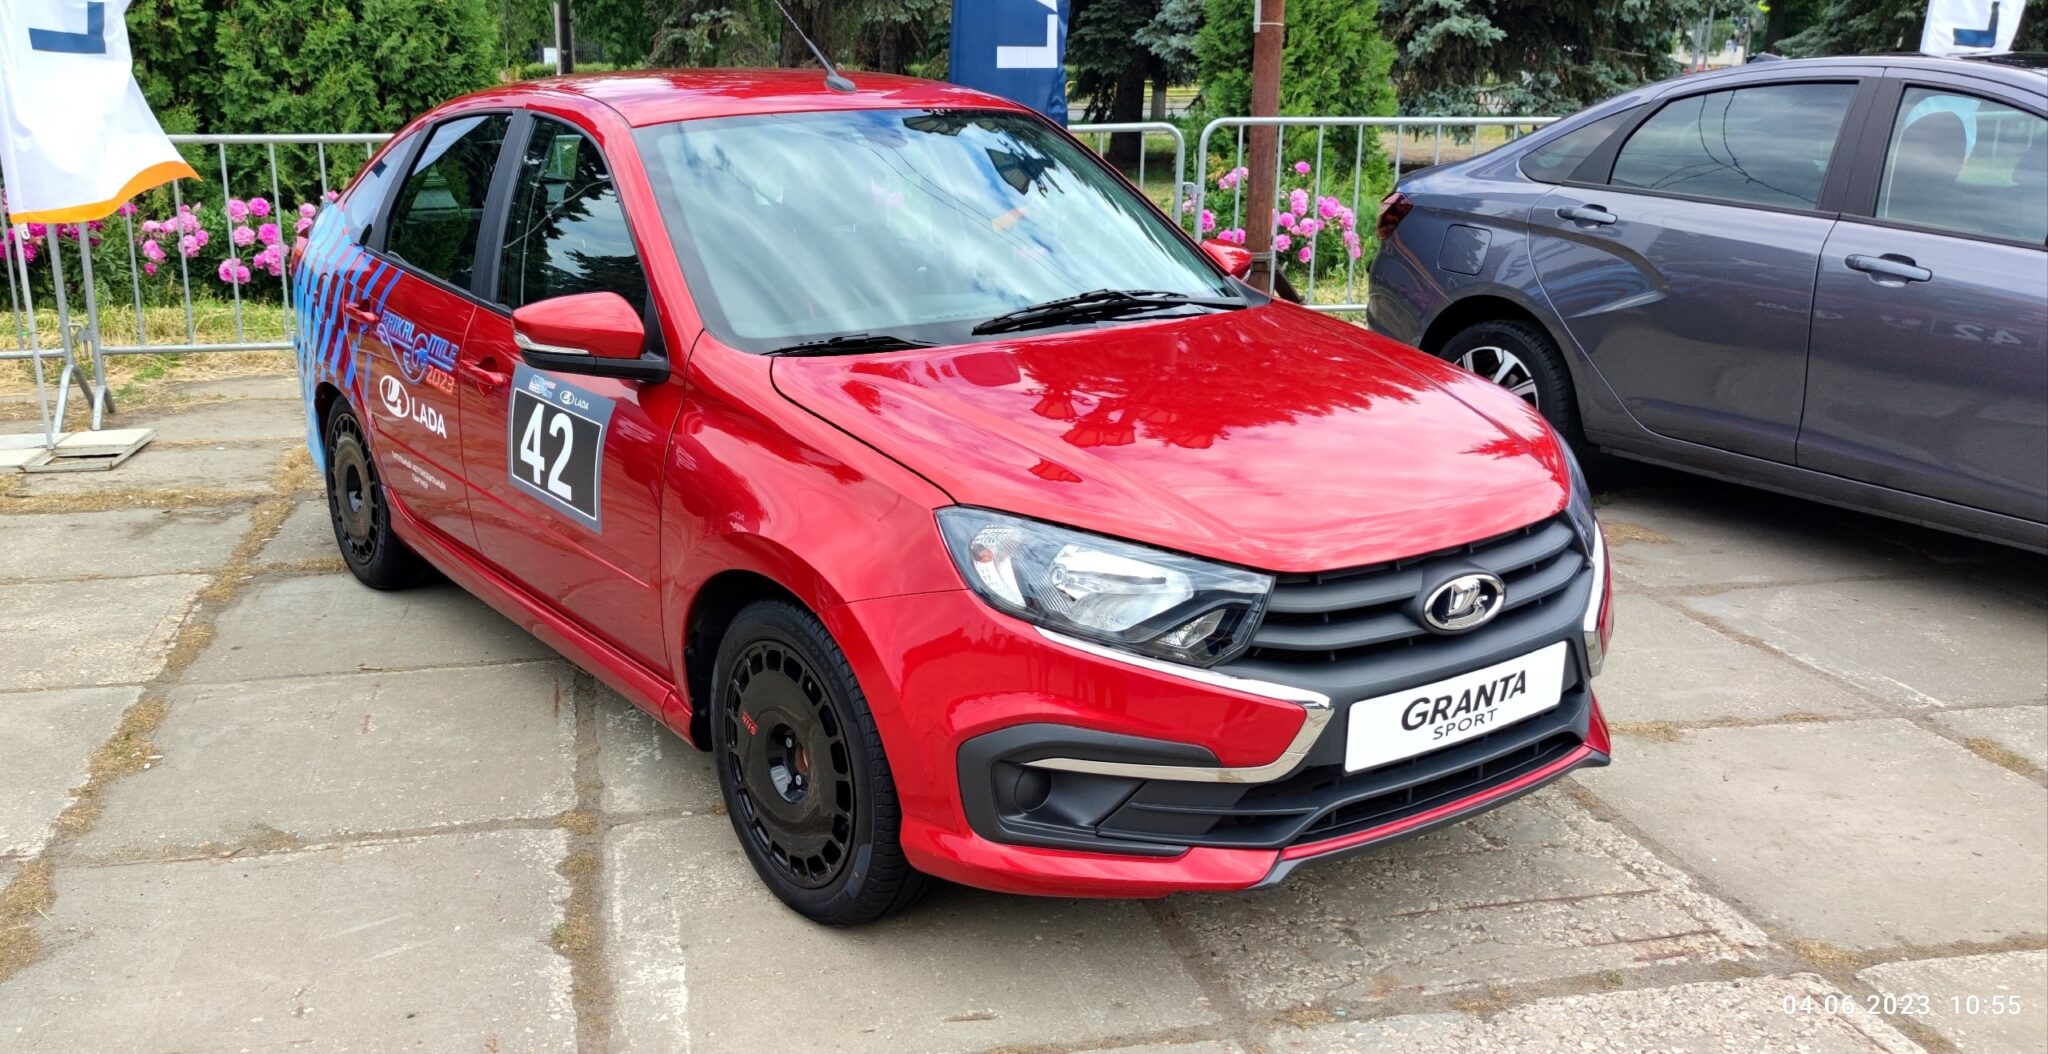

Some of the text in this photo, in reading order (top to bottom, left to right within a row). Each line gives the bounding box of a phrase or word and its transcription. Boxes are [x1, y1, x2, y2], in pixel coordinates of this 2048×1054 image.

[426, 365, 455, 393] 2023
[411, 397, 447, 439] LADA
[574, 397, 589, 410] LADA
[520, 402, 574, 501] 42
[1401, 669, 1526, 731] GRANTA
[1432, 708, 1498, 741] SPORT
